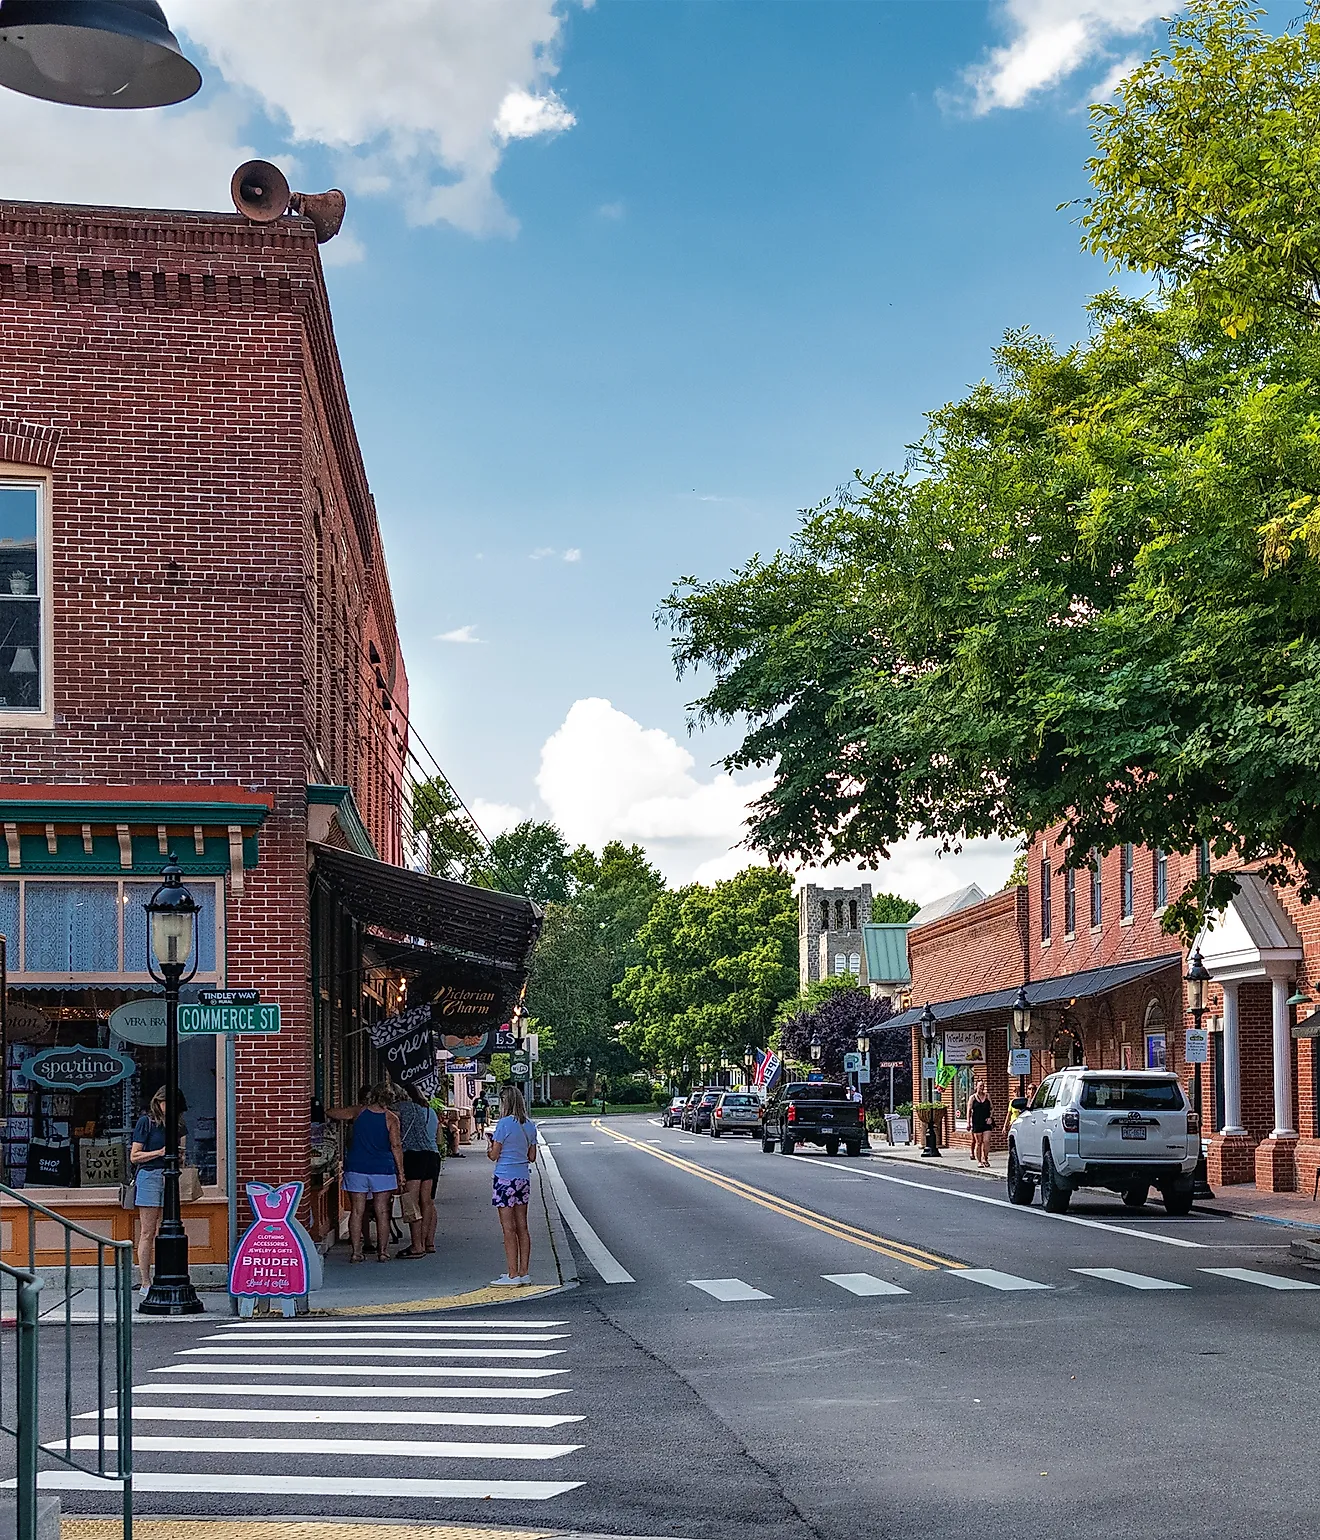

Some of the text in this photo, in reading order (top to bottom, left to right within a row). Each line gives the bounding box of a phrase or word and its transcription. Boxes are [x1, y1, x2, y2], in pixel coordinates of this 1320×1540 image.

[203, 991, 258, 1000] TINDLEY WAY
[430, 985, 496, 1004] Victorian
[442, 1000, 490, 1017] Charm
[124, 1017, 167, 1027] VERA BRA
[182, 1008, 275, 1030] COMMERCE ST
[41, 1056, 119, 1080] spartina
[86, 1158, 119, 1168] LOVE
[85, 1170, 119, 1179] WINE
[242, 1256, 298, 1266] BRUDER
[253, 1267, 286, 1277] HILL
